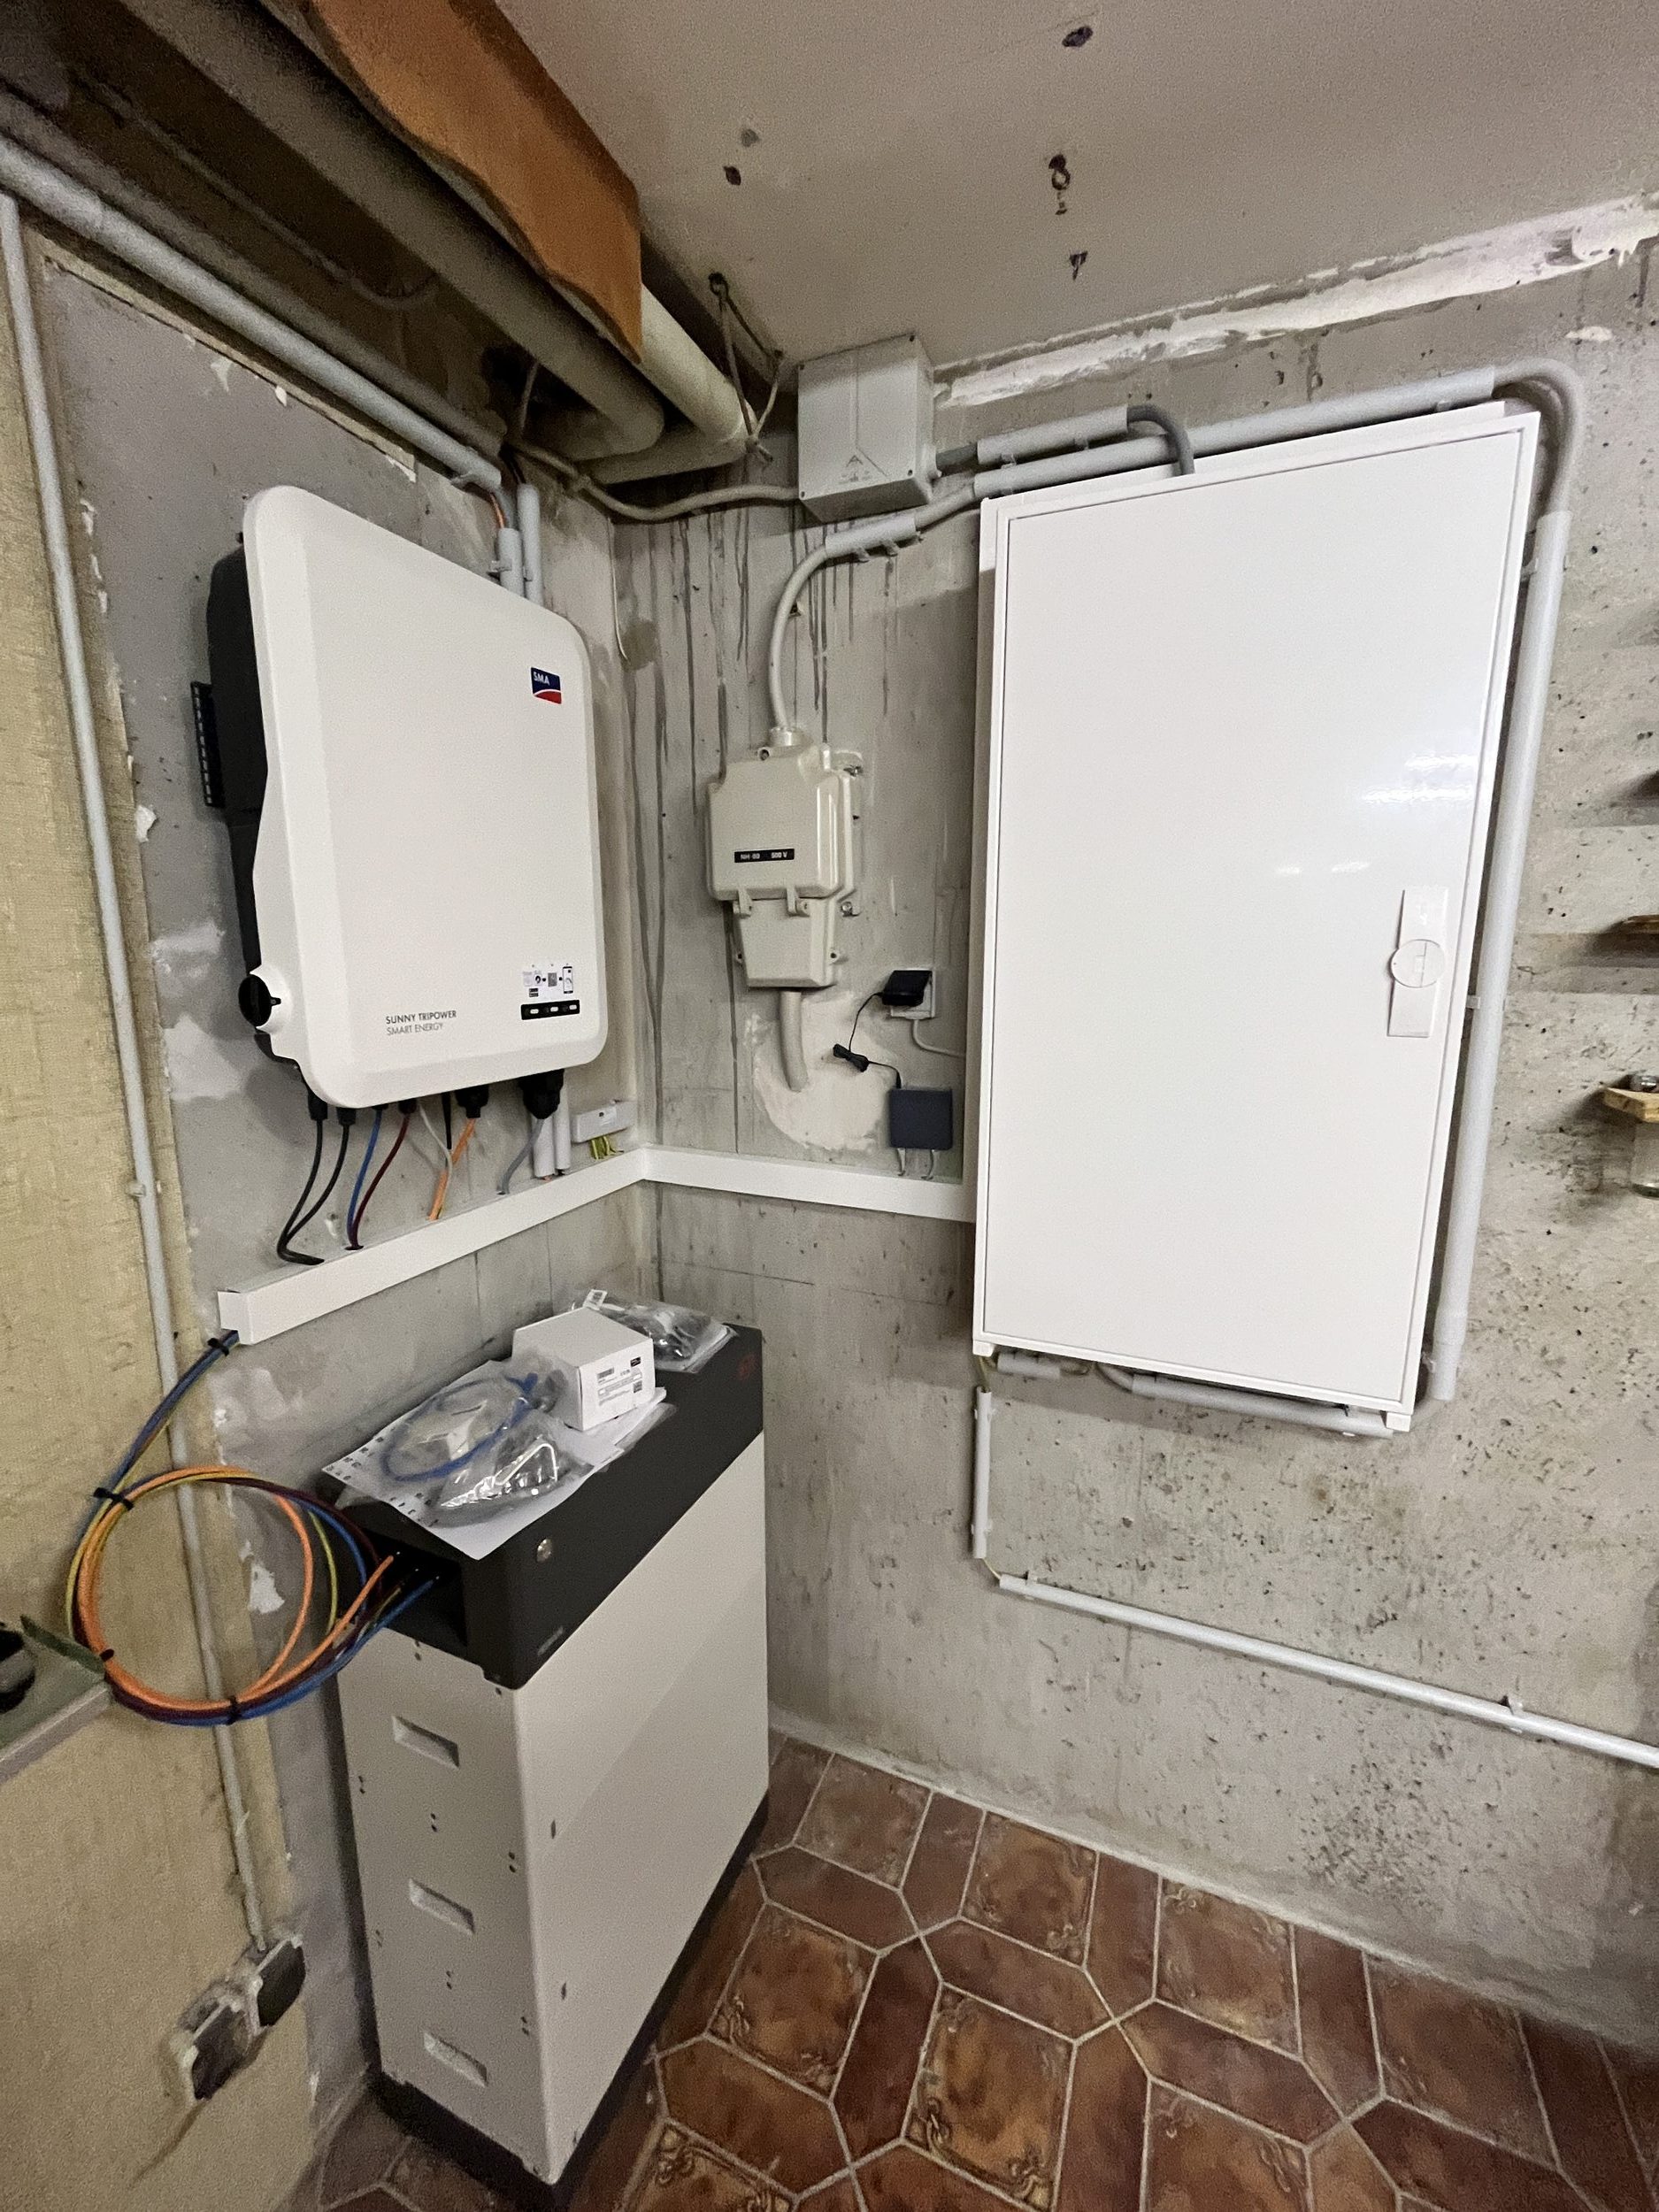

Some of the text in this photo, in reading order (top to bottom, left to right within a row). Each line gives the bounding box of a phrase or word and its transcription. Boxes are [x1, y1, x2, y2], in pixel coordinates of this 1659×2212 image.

[534, 672, 549, 686] SMA
[386, 1010, 457, 1025] SUNNY TRIPOWER
[387, 1023, 443, 1035] SMART ENERGY
